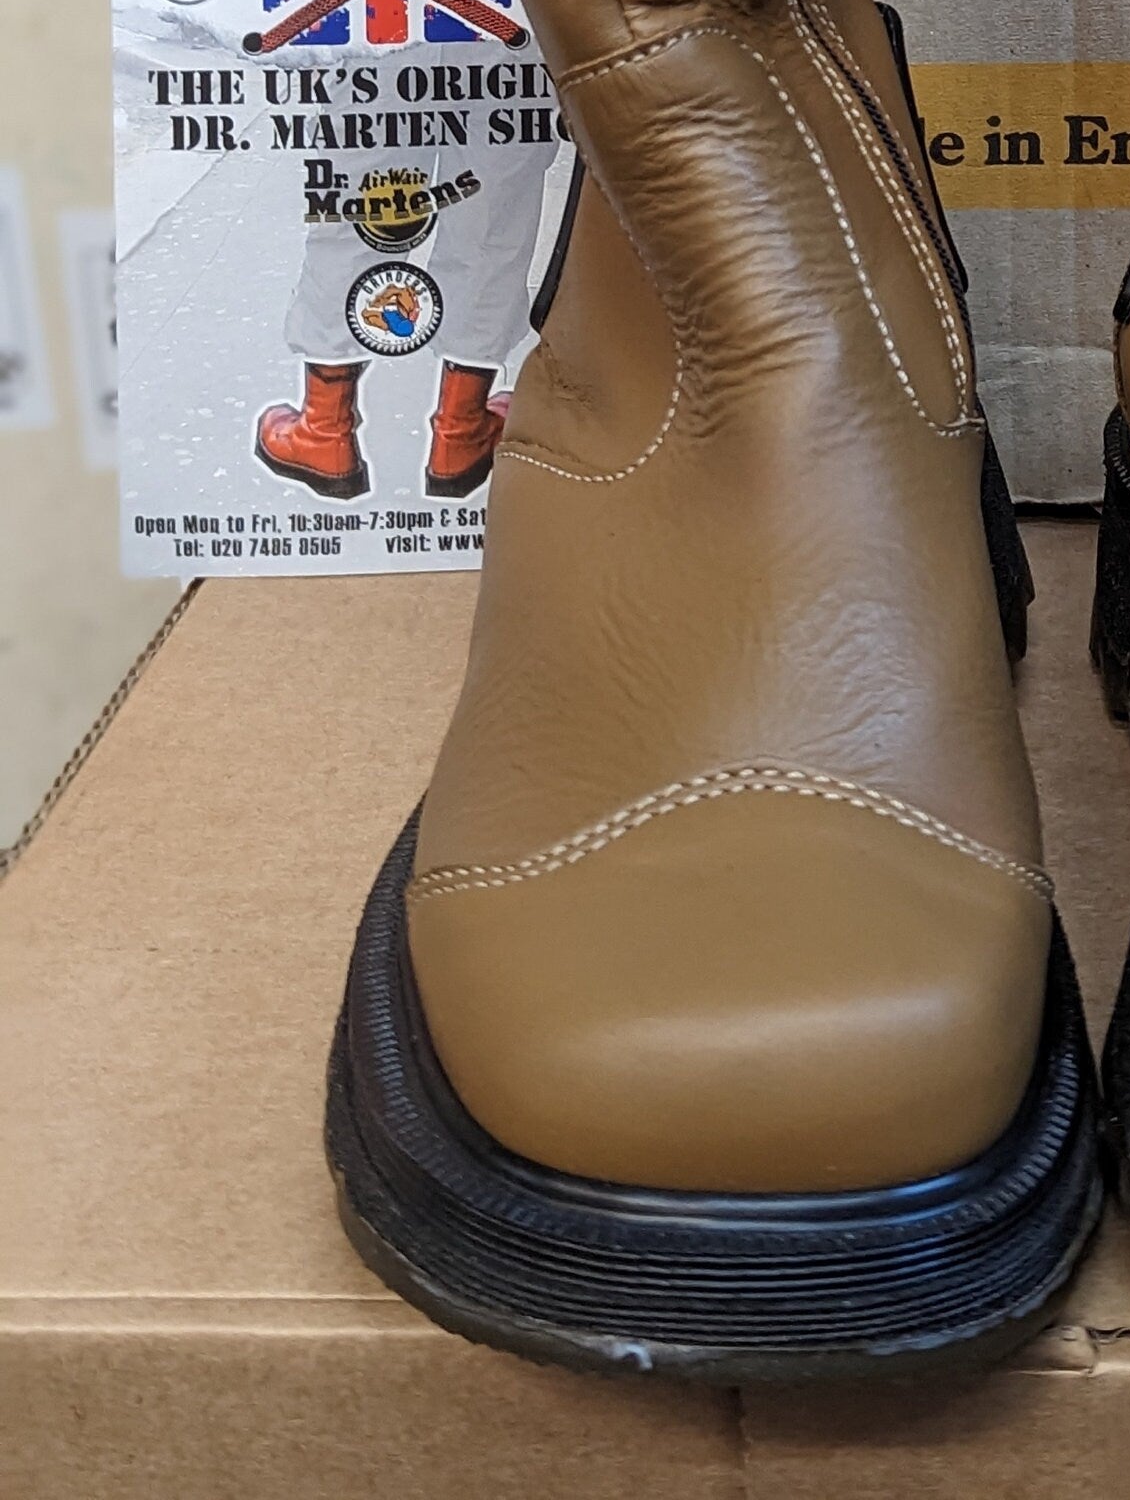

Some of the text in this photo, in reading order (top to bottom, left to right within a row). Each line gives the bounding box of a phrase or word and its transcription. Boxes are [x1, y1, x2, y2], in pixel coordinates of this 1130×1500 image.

[149, 69, 245, 106] THE
[263, 66, 380, 105] UK'S
[170, 115, 251, 152] DR.
[270, 110, 471, 151] MARTEN
[984, 115, 1042, 166] in
[304, 158, 349, 190] Dr.
[304, 169, 482, 223] Martens
[134, 515, 176, 537] Open
[183, 514, 220, 534] Mon
[227, 515, 245, 533] to
[456, 508, 487, 527] Sat
